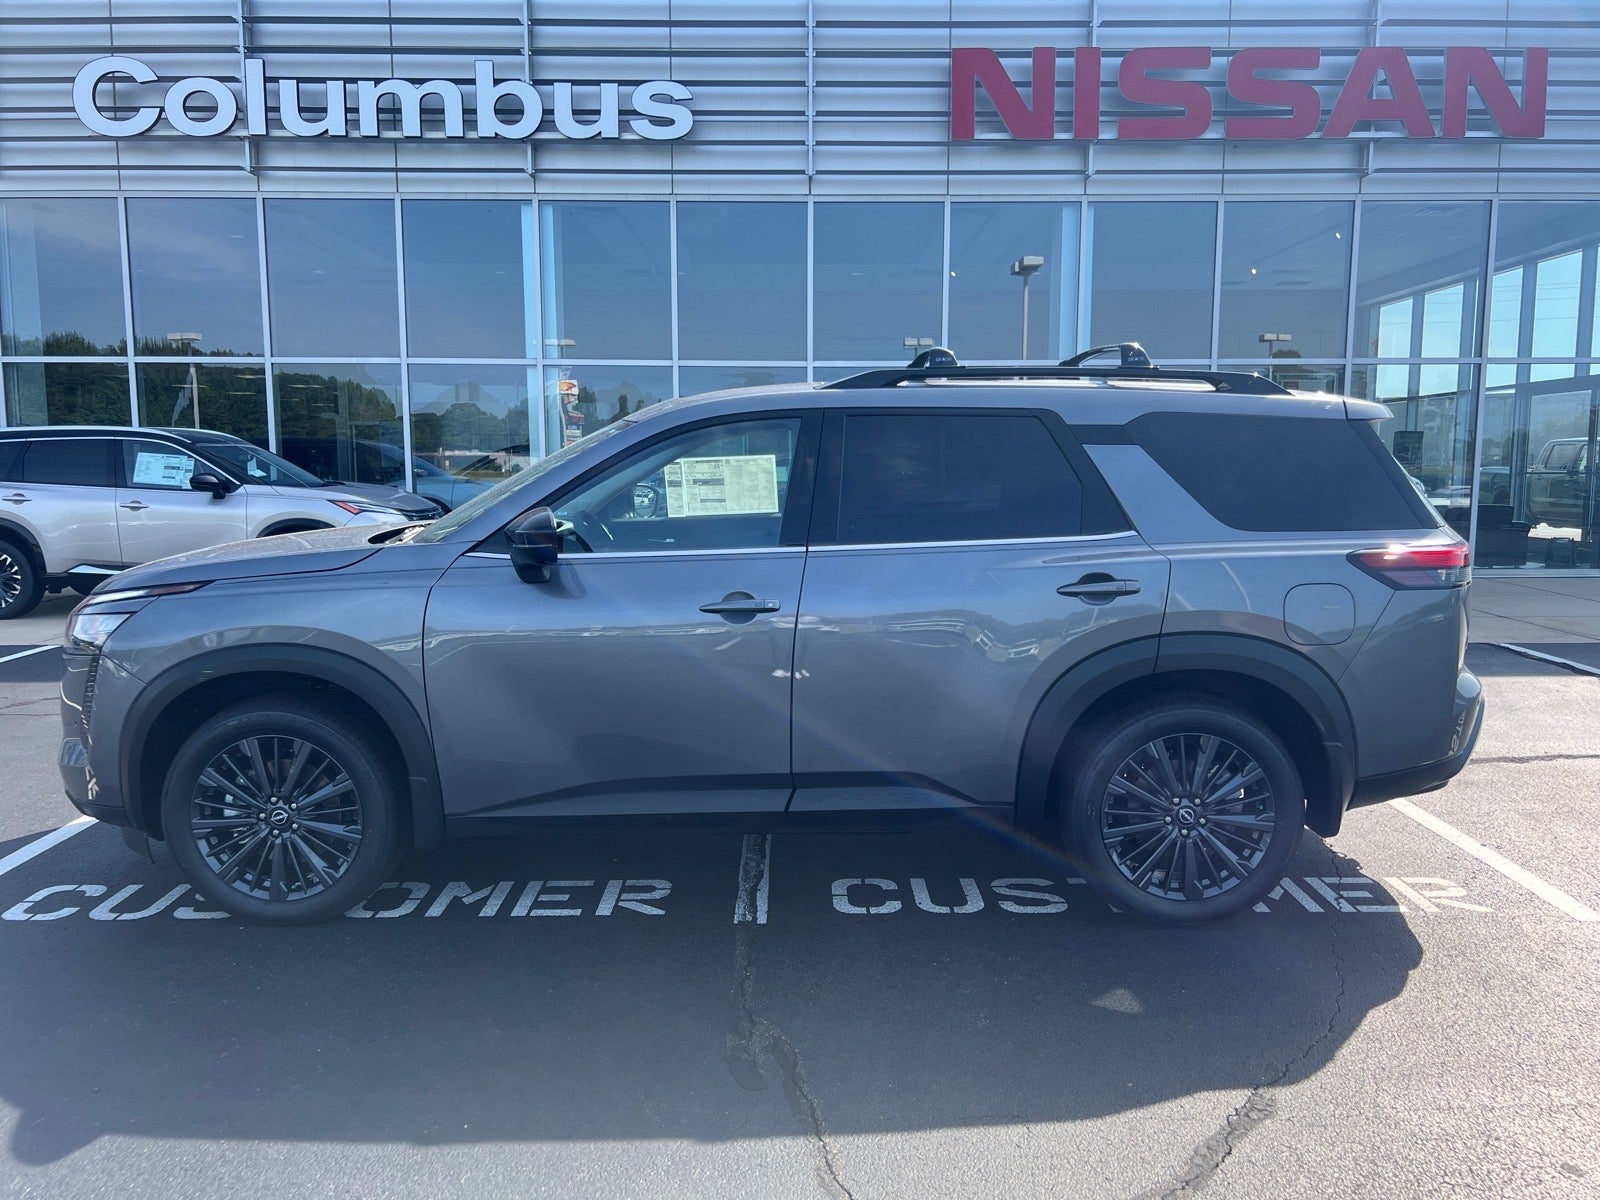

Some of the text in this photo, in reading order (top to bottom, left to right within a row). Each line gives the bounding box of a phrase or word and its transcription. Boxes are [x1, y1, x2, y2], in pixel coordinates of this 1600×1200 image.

[72, 55, 694, 140] Columbus
[951, 46, 1549, 140] NISSAN
[1, 879, 673, 921] CUOMER
[831, 877, 1495, 914] CUSMER
